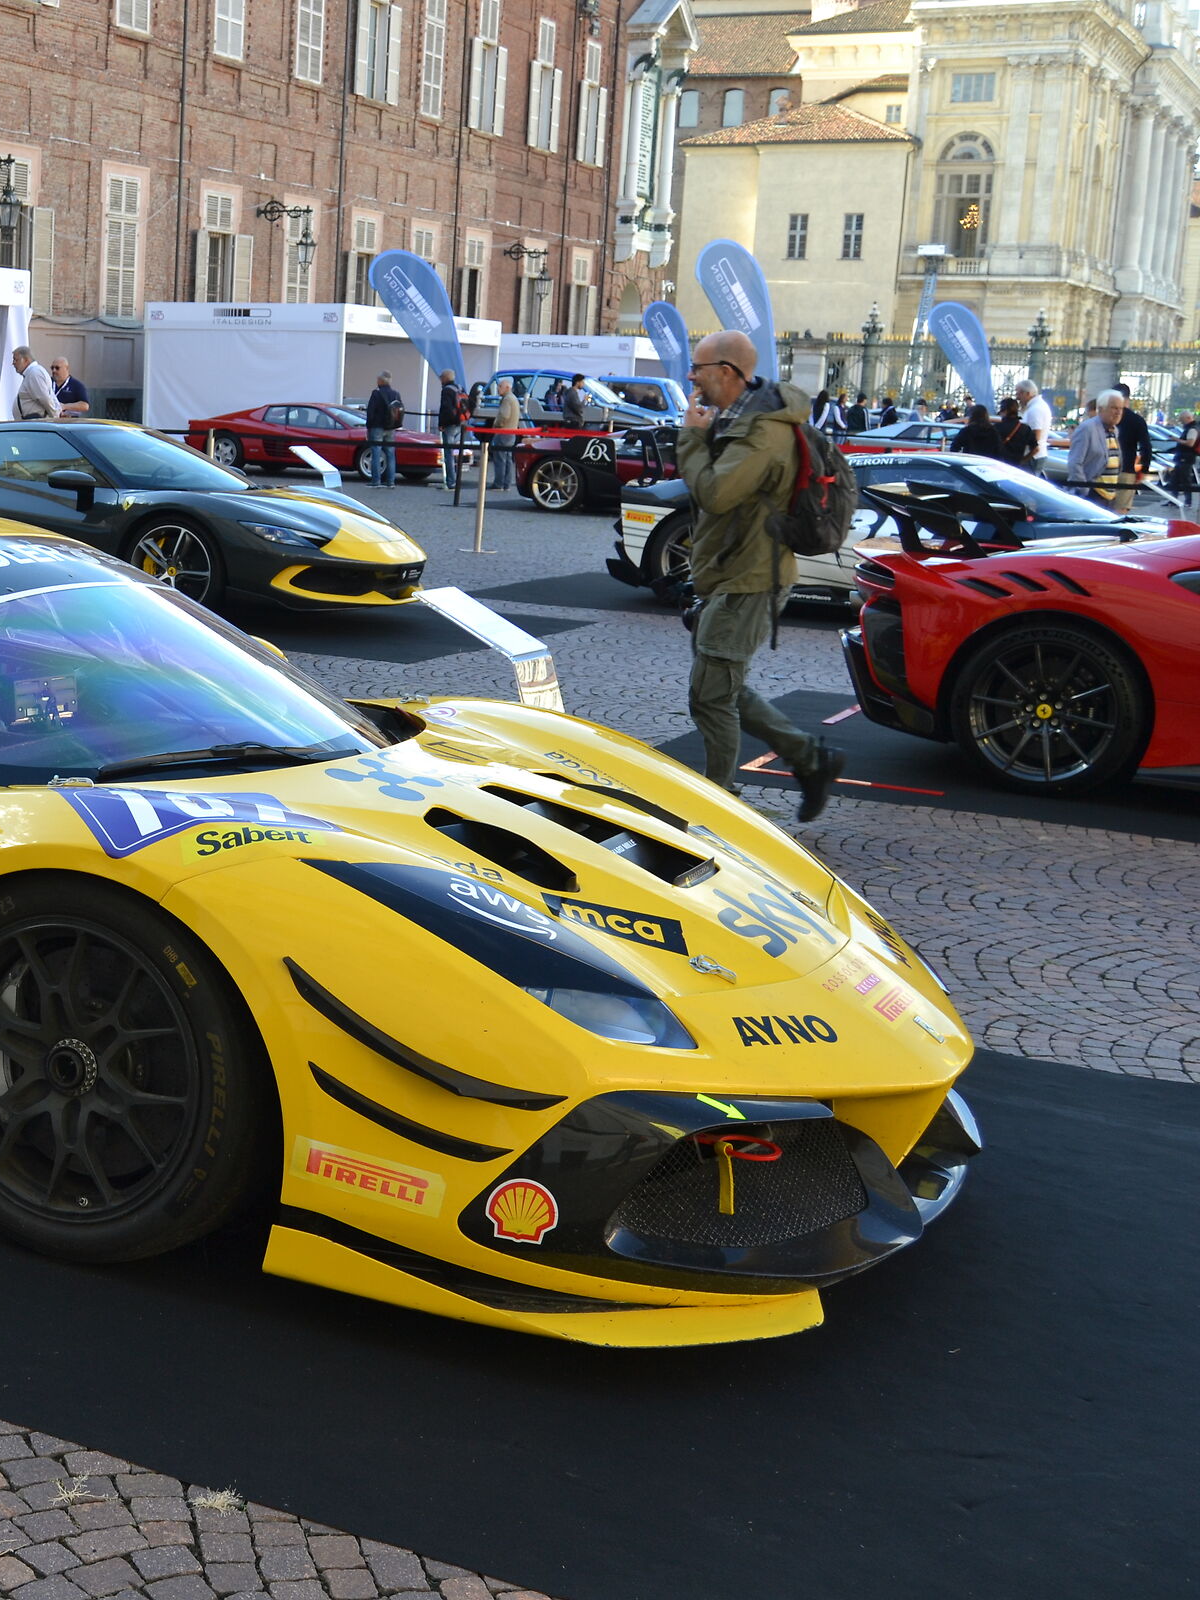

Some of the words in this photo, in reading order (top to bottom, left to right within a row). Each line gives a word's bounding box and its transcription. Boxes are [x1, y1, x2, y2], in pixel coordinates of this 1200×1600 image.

[212, 318, 272, 326] ITALDESIGN
[521, 341, 590, 349] PORSCHE
[848, 457, 895, 467] PERONI
[195, 827, 313, 856] Sabelt
[450, 877, 550, 926] aws
[561, 902, 666, 945] mca
[693, 884, 837, 959] sky
[873, 986, 916, 1022] PIRELLI
[732, 1014, 839, 1047] AYNO
[204, 1031, 228, 1158] PIRELLI
[305, 1147, 430, 1206] PIRELLI
